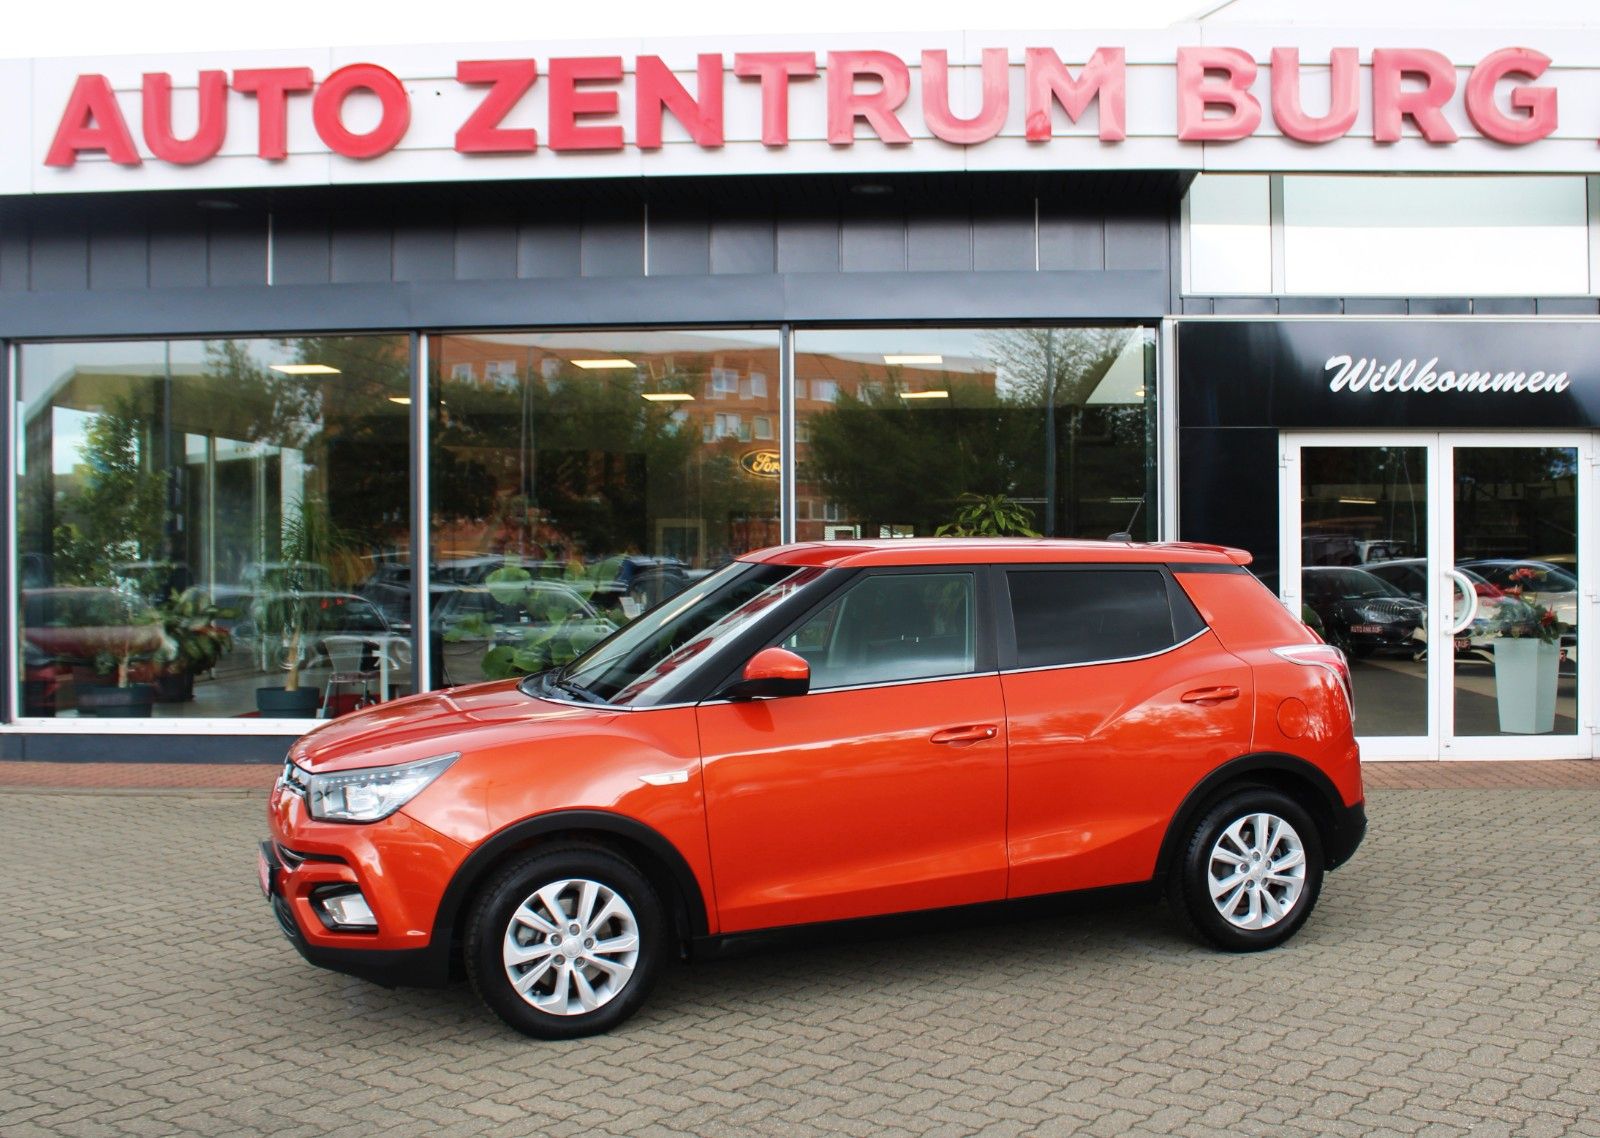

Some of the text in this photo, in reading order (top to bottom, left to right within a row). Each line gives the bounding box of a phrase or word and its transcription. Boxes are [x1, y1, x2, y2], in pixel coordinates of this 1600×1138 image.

[44, 46, 1558, 167] AUTO ZENTRUM BURG
[1324, 354, 1570, 393] Willkommen
[752, 452, 781, 473] For
